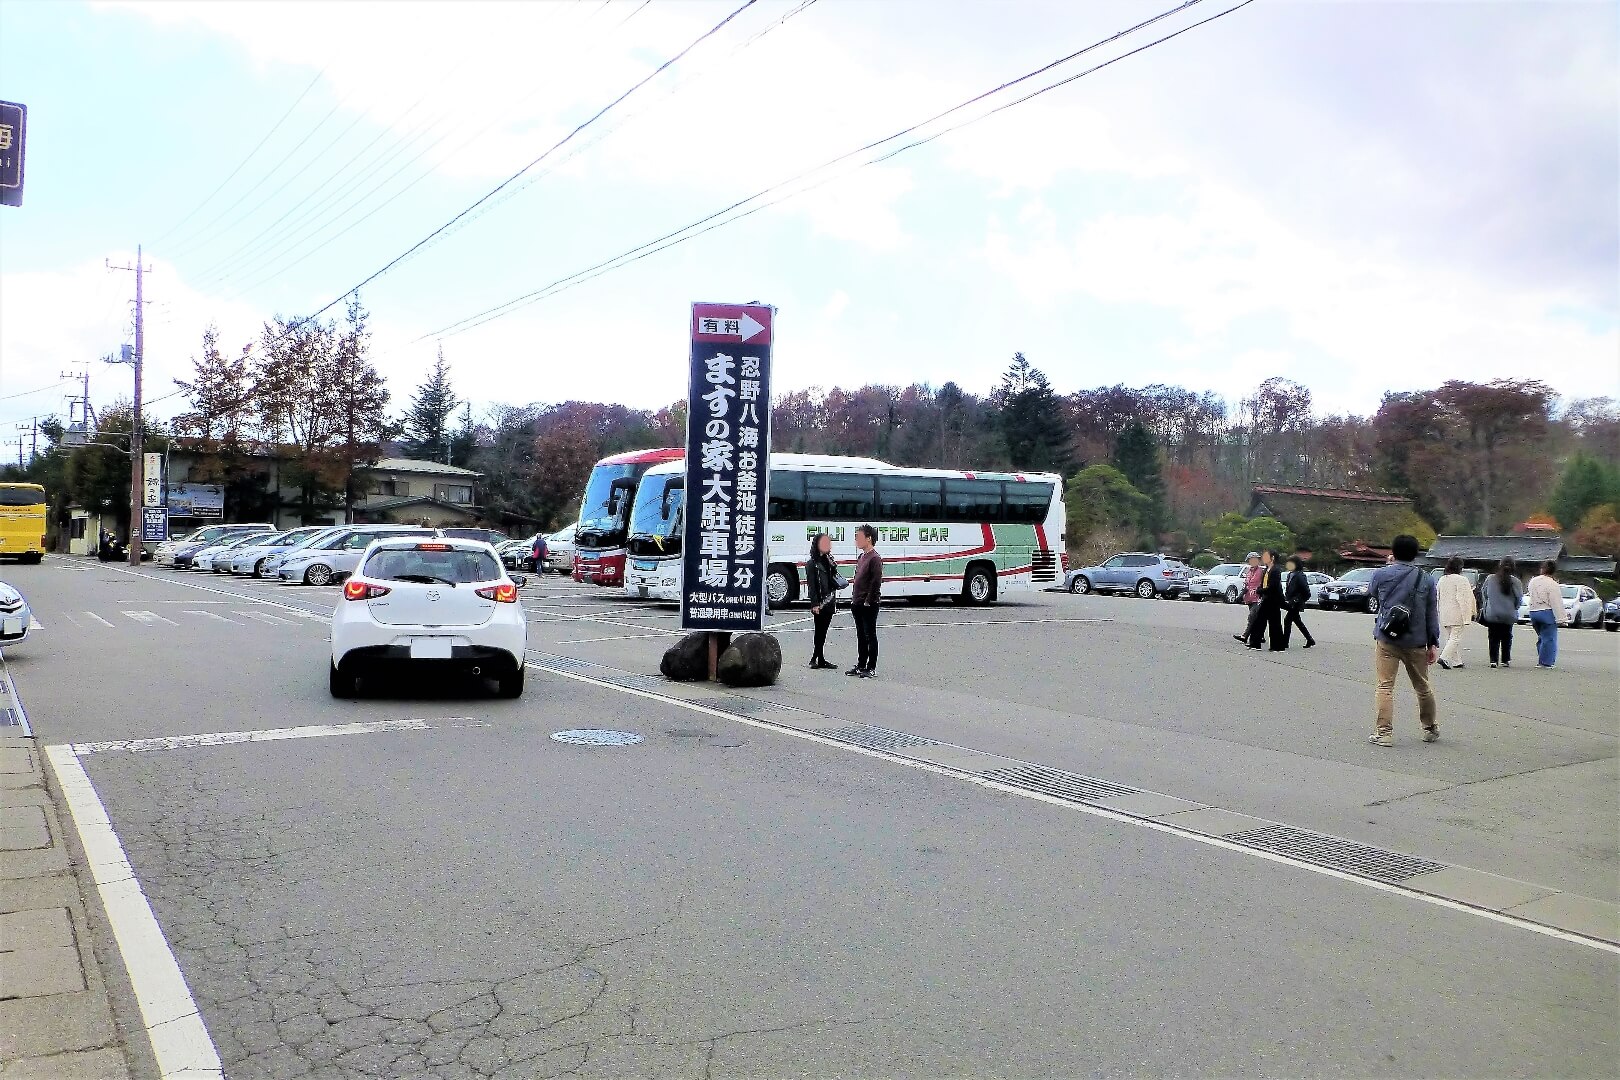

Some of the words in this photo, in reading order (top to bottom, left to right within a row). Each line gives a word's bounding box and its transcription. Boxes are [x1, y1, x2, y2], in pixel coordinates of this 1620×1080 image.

[703, 319, 739, 333] 有料
[699, 353, 736, 588] ますの家大駐車場
[855, 527, 909, 542] TOR
[918, 528, 950, 542] CAR
[689, 592, 725, 603] 大型バス
[689, 607, 729, 620] 普通乗用車
